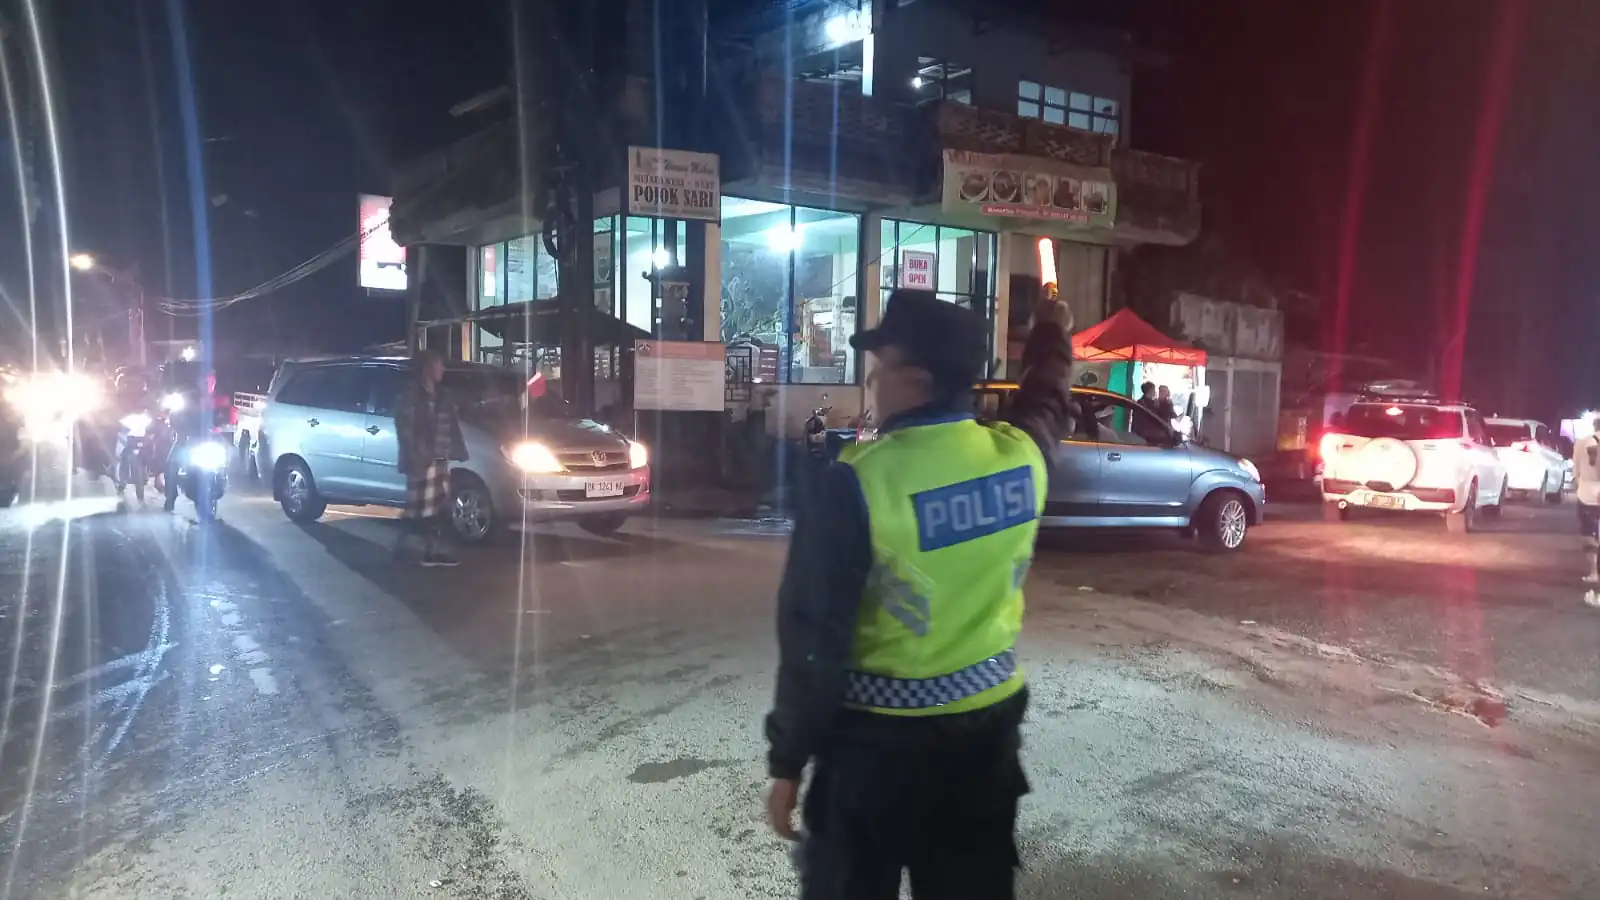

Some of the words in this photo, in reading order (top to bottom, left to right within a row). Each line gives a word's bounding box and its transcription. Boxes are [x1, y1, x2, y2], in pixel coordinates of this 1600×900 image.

[634, 185, 679, 205] POJOK
[683, 188, 714, 208] SARI
[909, 259, 927, 270] BUKA
[909, 273, 926, 284] OPEN
[924, 477, 1034, 538] POLISI
